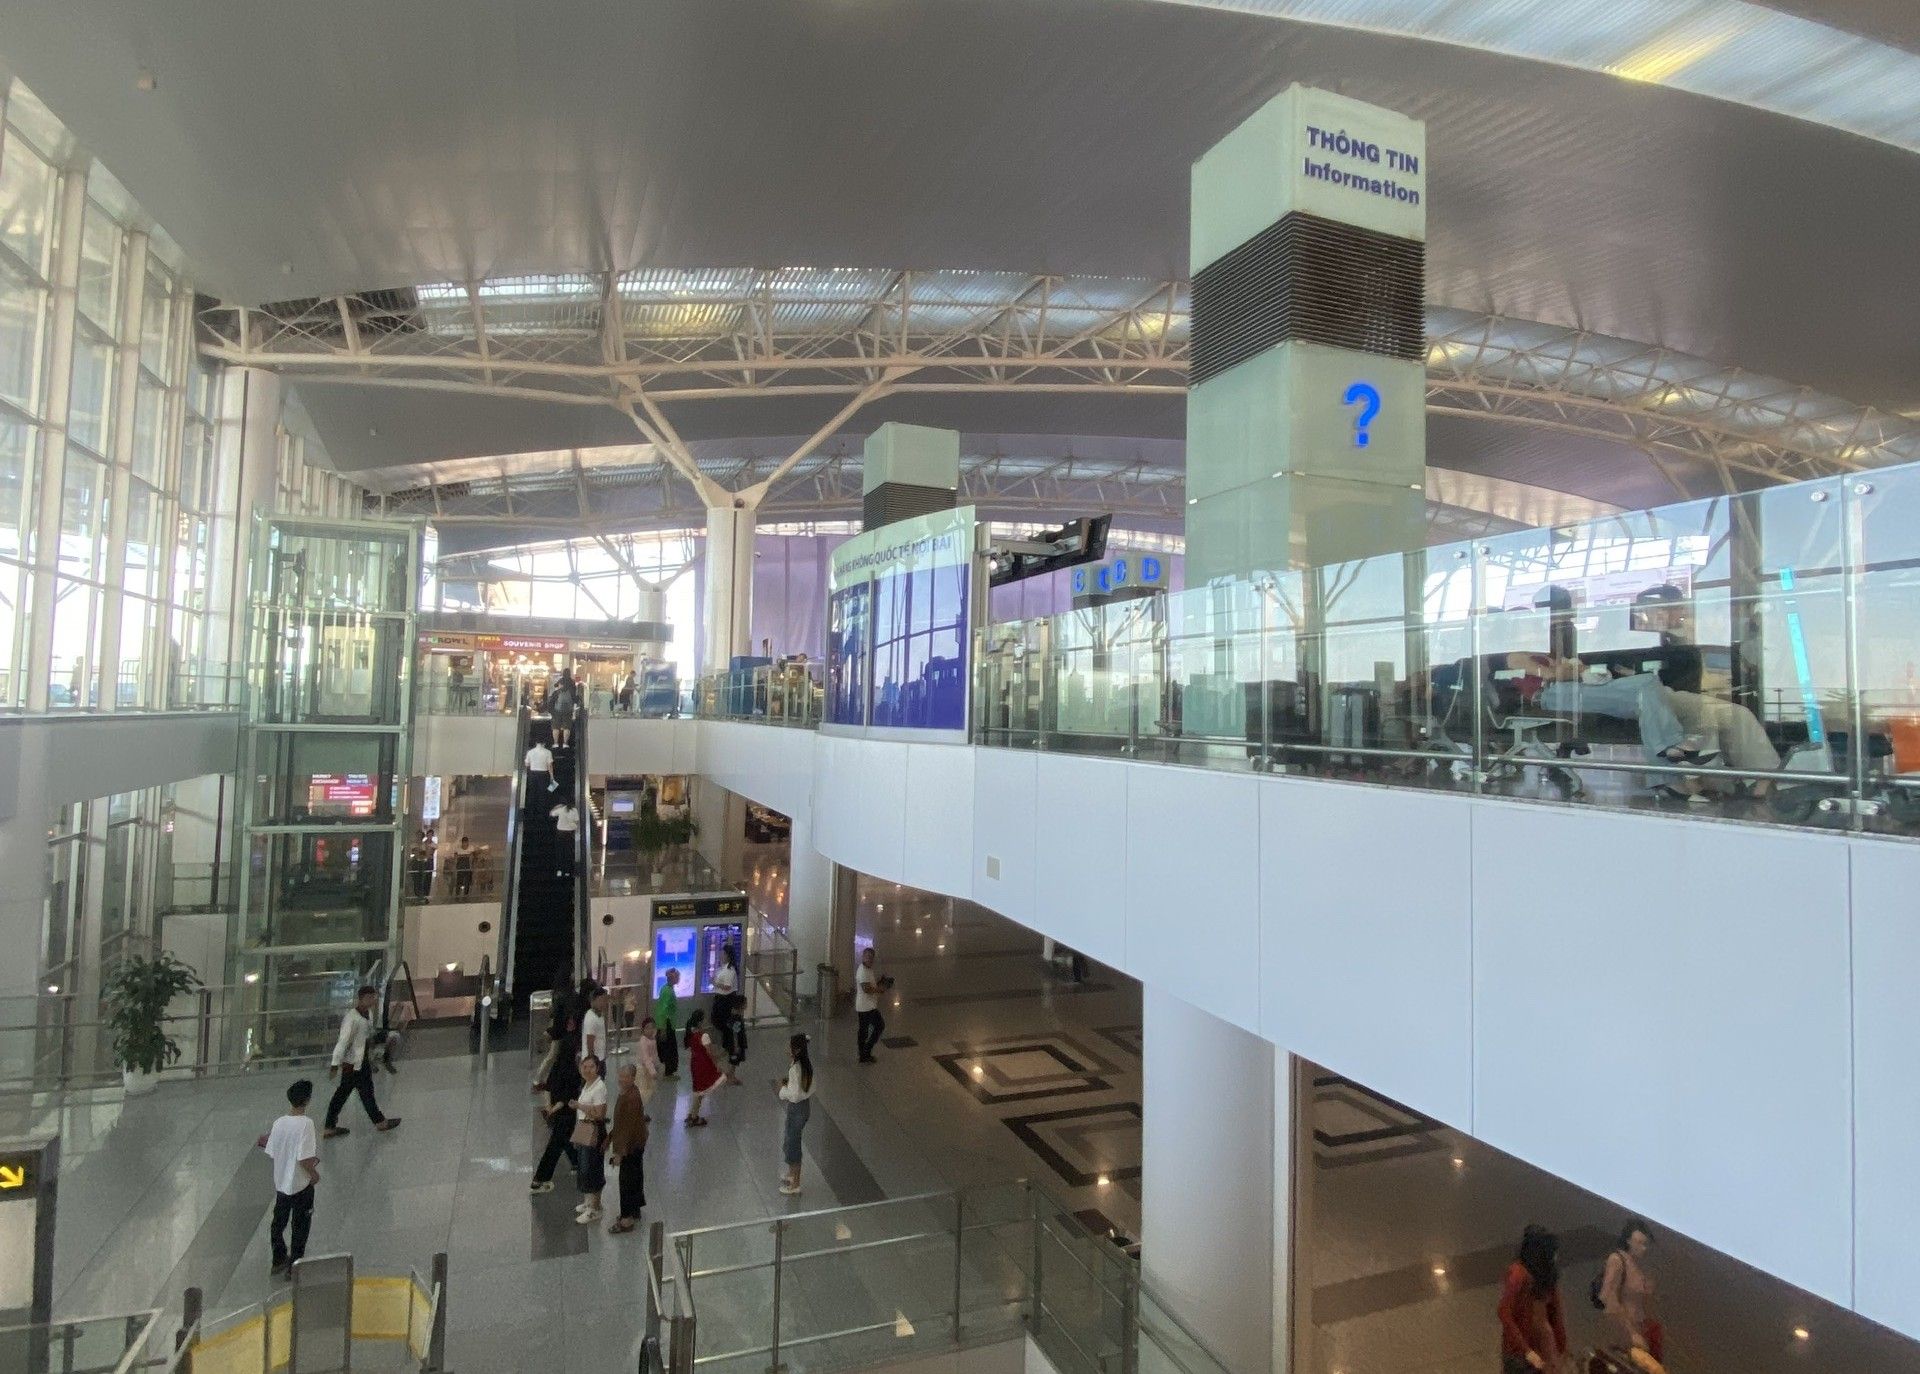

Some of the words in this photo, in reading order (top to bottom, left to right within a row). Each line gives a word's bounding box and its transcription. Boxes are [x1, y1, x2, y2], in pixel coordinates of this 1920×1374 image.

[1306, 125, 1380, 164] THÔNG
[1386, 148, 1419, 175] TIN
[1303, 157, 1420, 205] Information
[1142, 556, 1162, 582] D
[503, 640, 542, 649] SOUVENIR
[544, 642, 565, 650] SHOP
